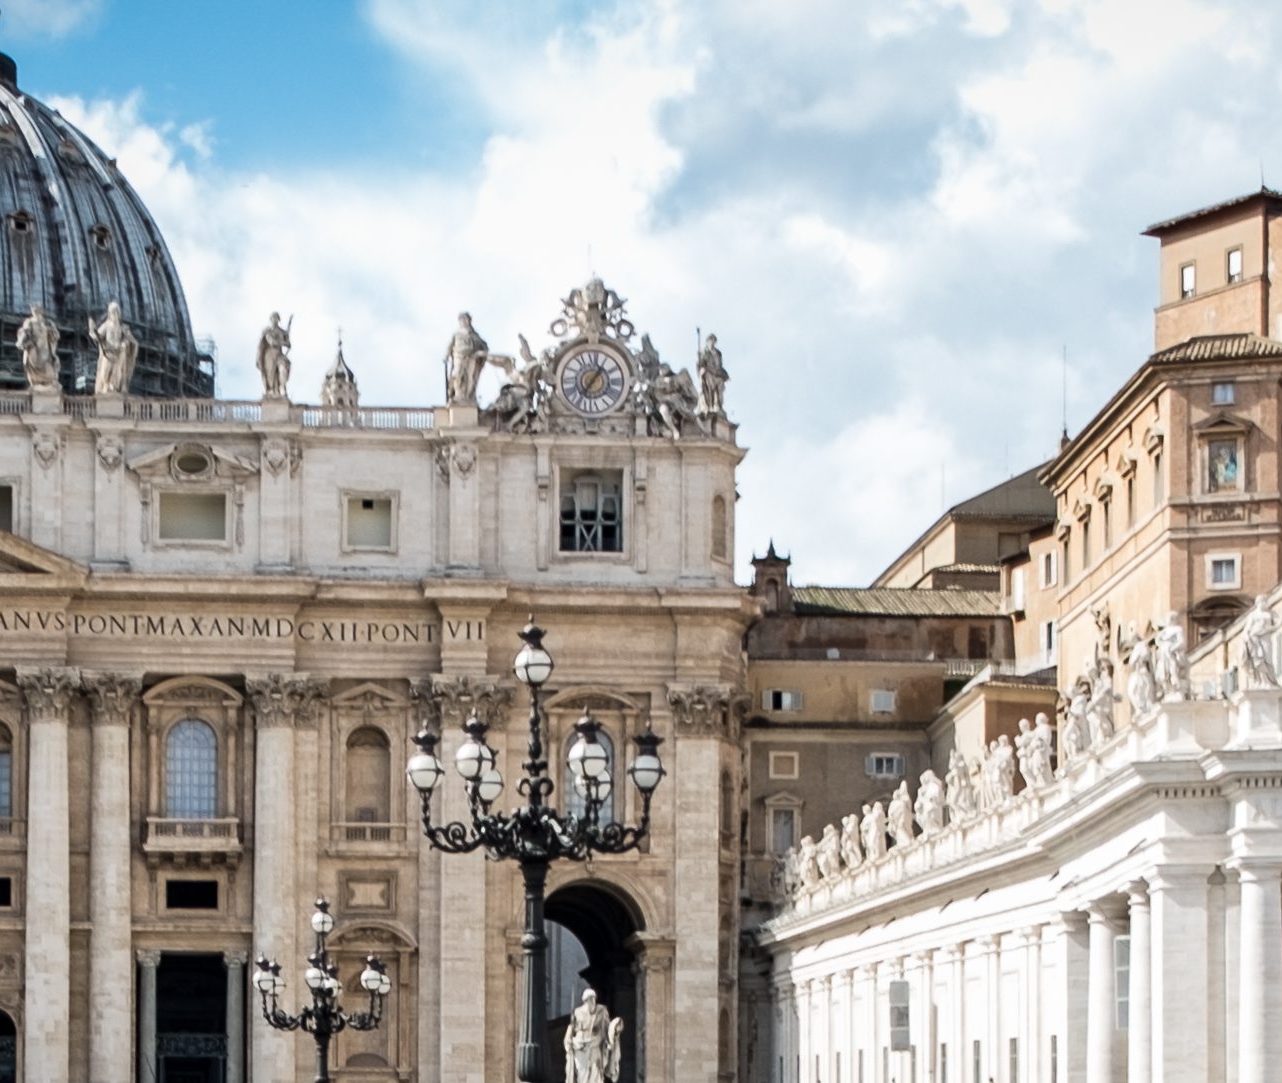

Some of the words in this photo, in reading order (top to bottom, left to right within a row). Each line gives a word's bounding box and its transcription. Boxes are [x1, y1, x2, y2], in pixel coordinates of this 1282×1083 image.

[73, 614, 142, 635] PONT
[146, 615, 204, 637] MAX
[209, 616, 245, 637] AN
[252, 617, 358, 643] MDCXII
[367, 622, 437, 643] PONT
[447, 620, 483, 640] VII
